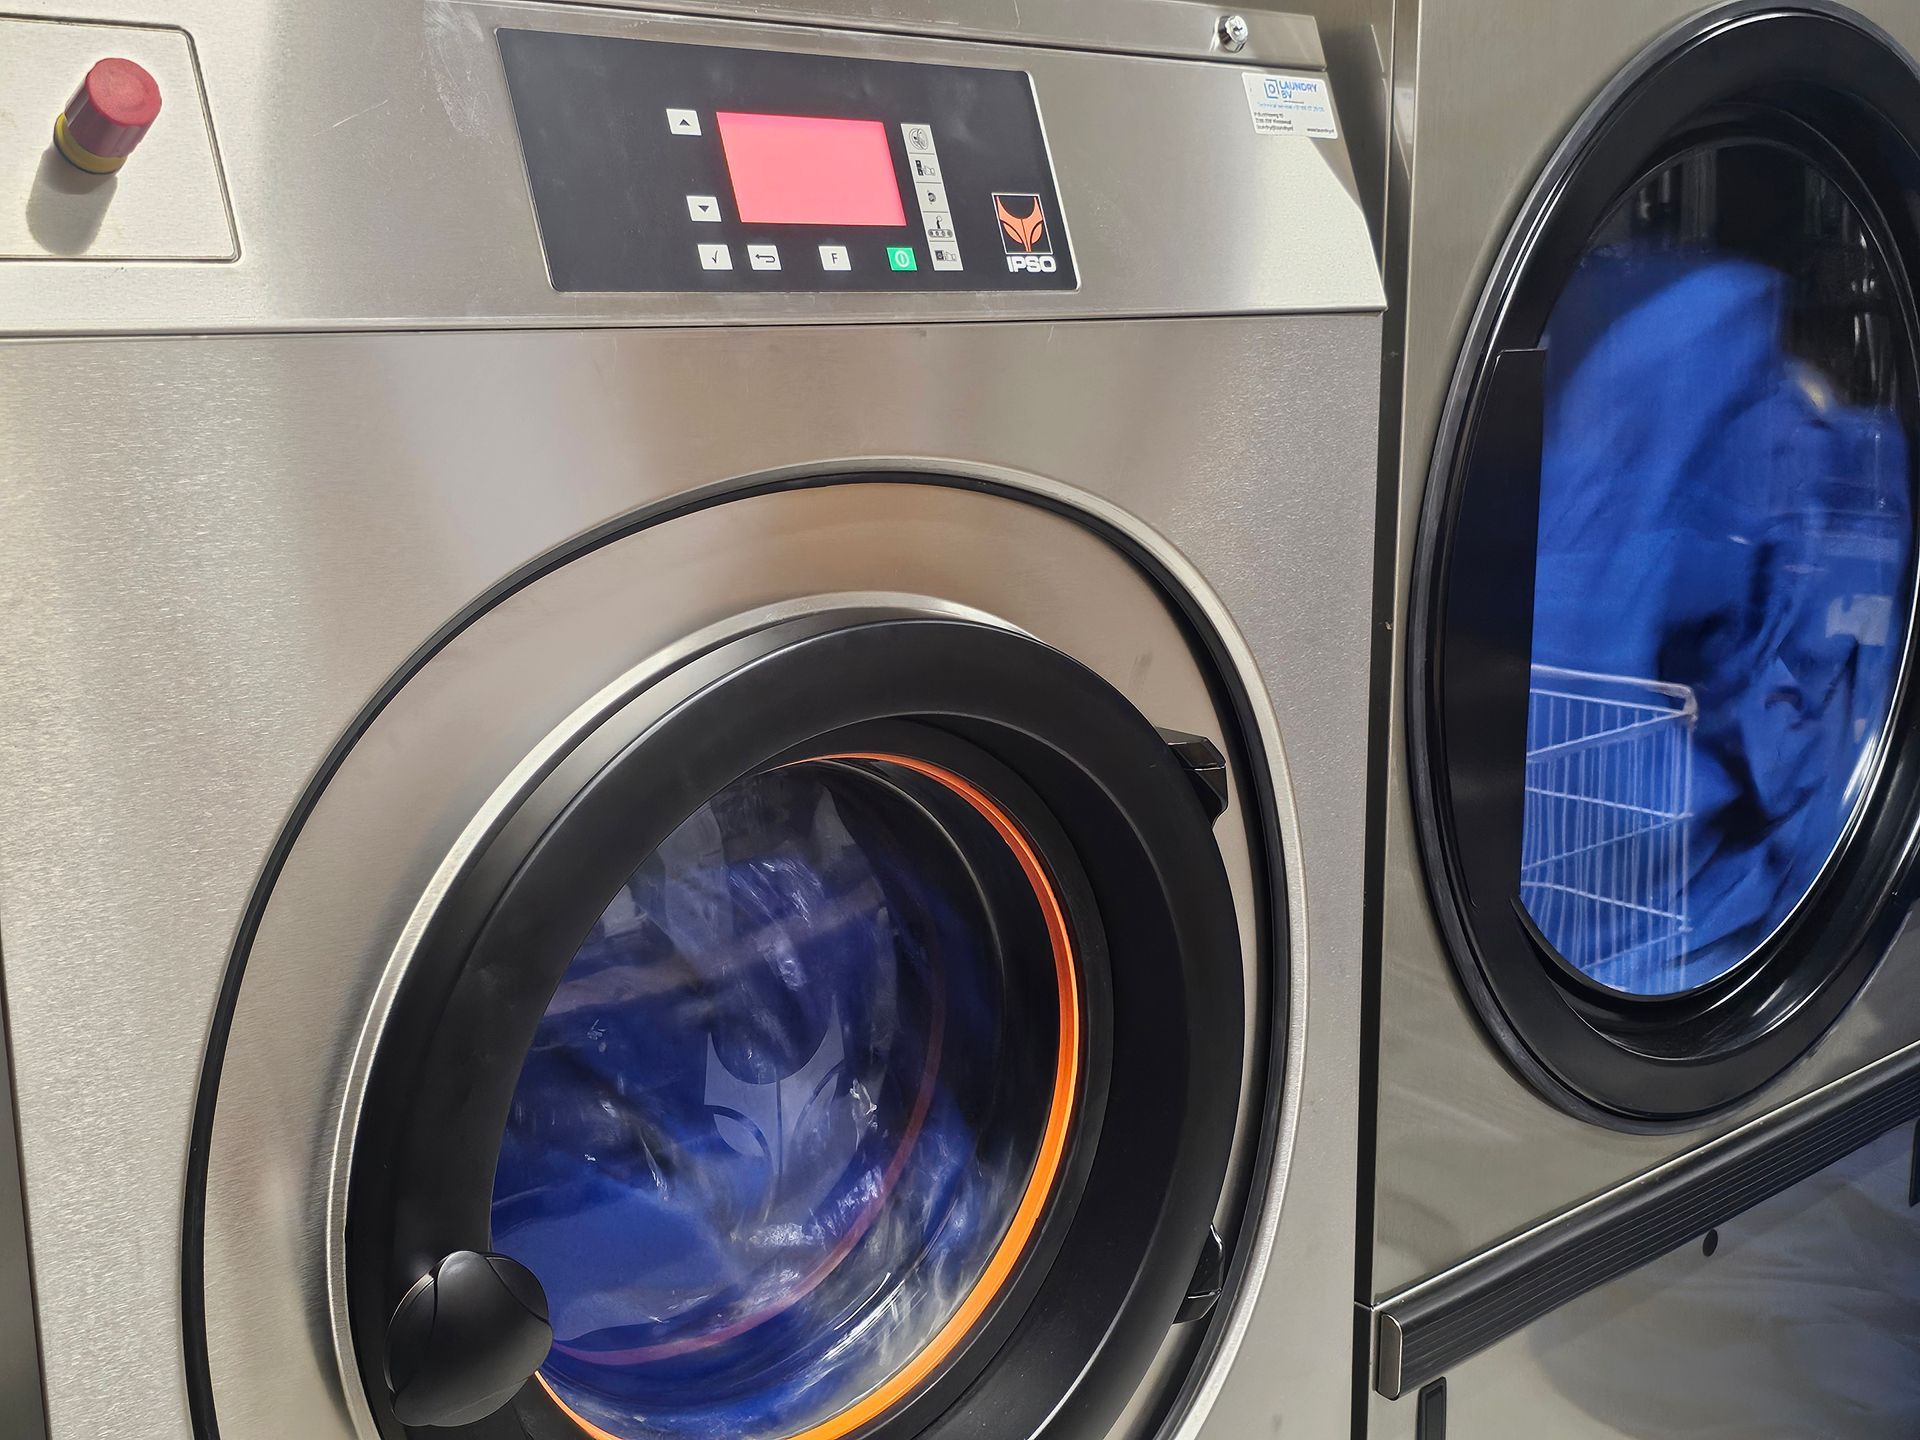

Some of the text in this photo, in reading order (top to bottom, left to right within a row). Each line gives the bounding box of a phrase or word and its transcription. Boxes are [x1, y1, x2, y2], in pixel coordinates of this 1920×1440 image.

[1279, 80, 1317, 92] LAUNDRY
[831, 252, 838, 264] F
[1006, 255, 1057, 273] IPSO
